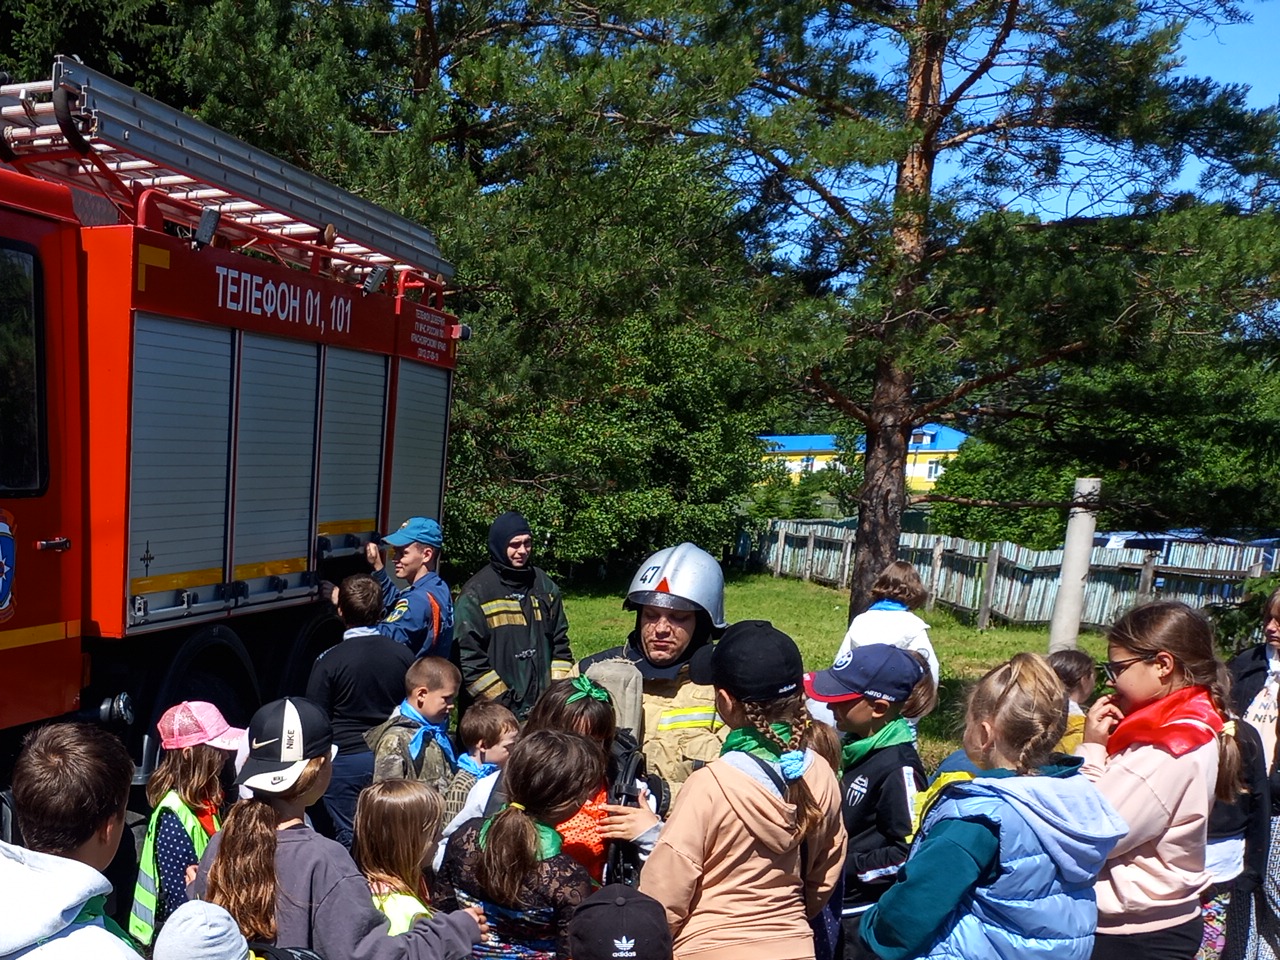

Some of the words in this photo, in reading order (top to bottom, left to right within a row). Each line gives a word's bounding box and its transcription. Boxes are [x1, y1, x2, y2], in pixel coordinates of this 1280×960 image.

[215, 265, 300, 323] ТЕЛЕФОН
[305, 289, 325, 335] 01,
[330, 295, 351, 334] 101
[639, 565, 661, 584] 47
[285, 728, 296, 751] NIKE
